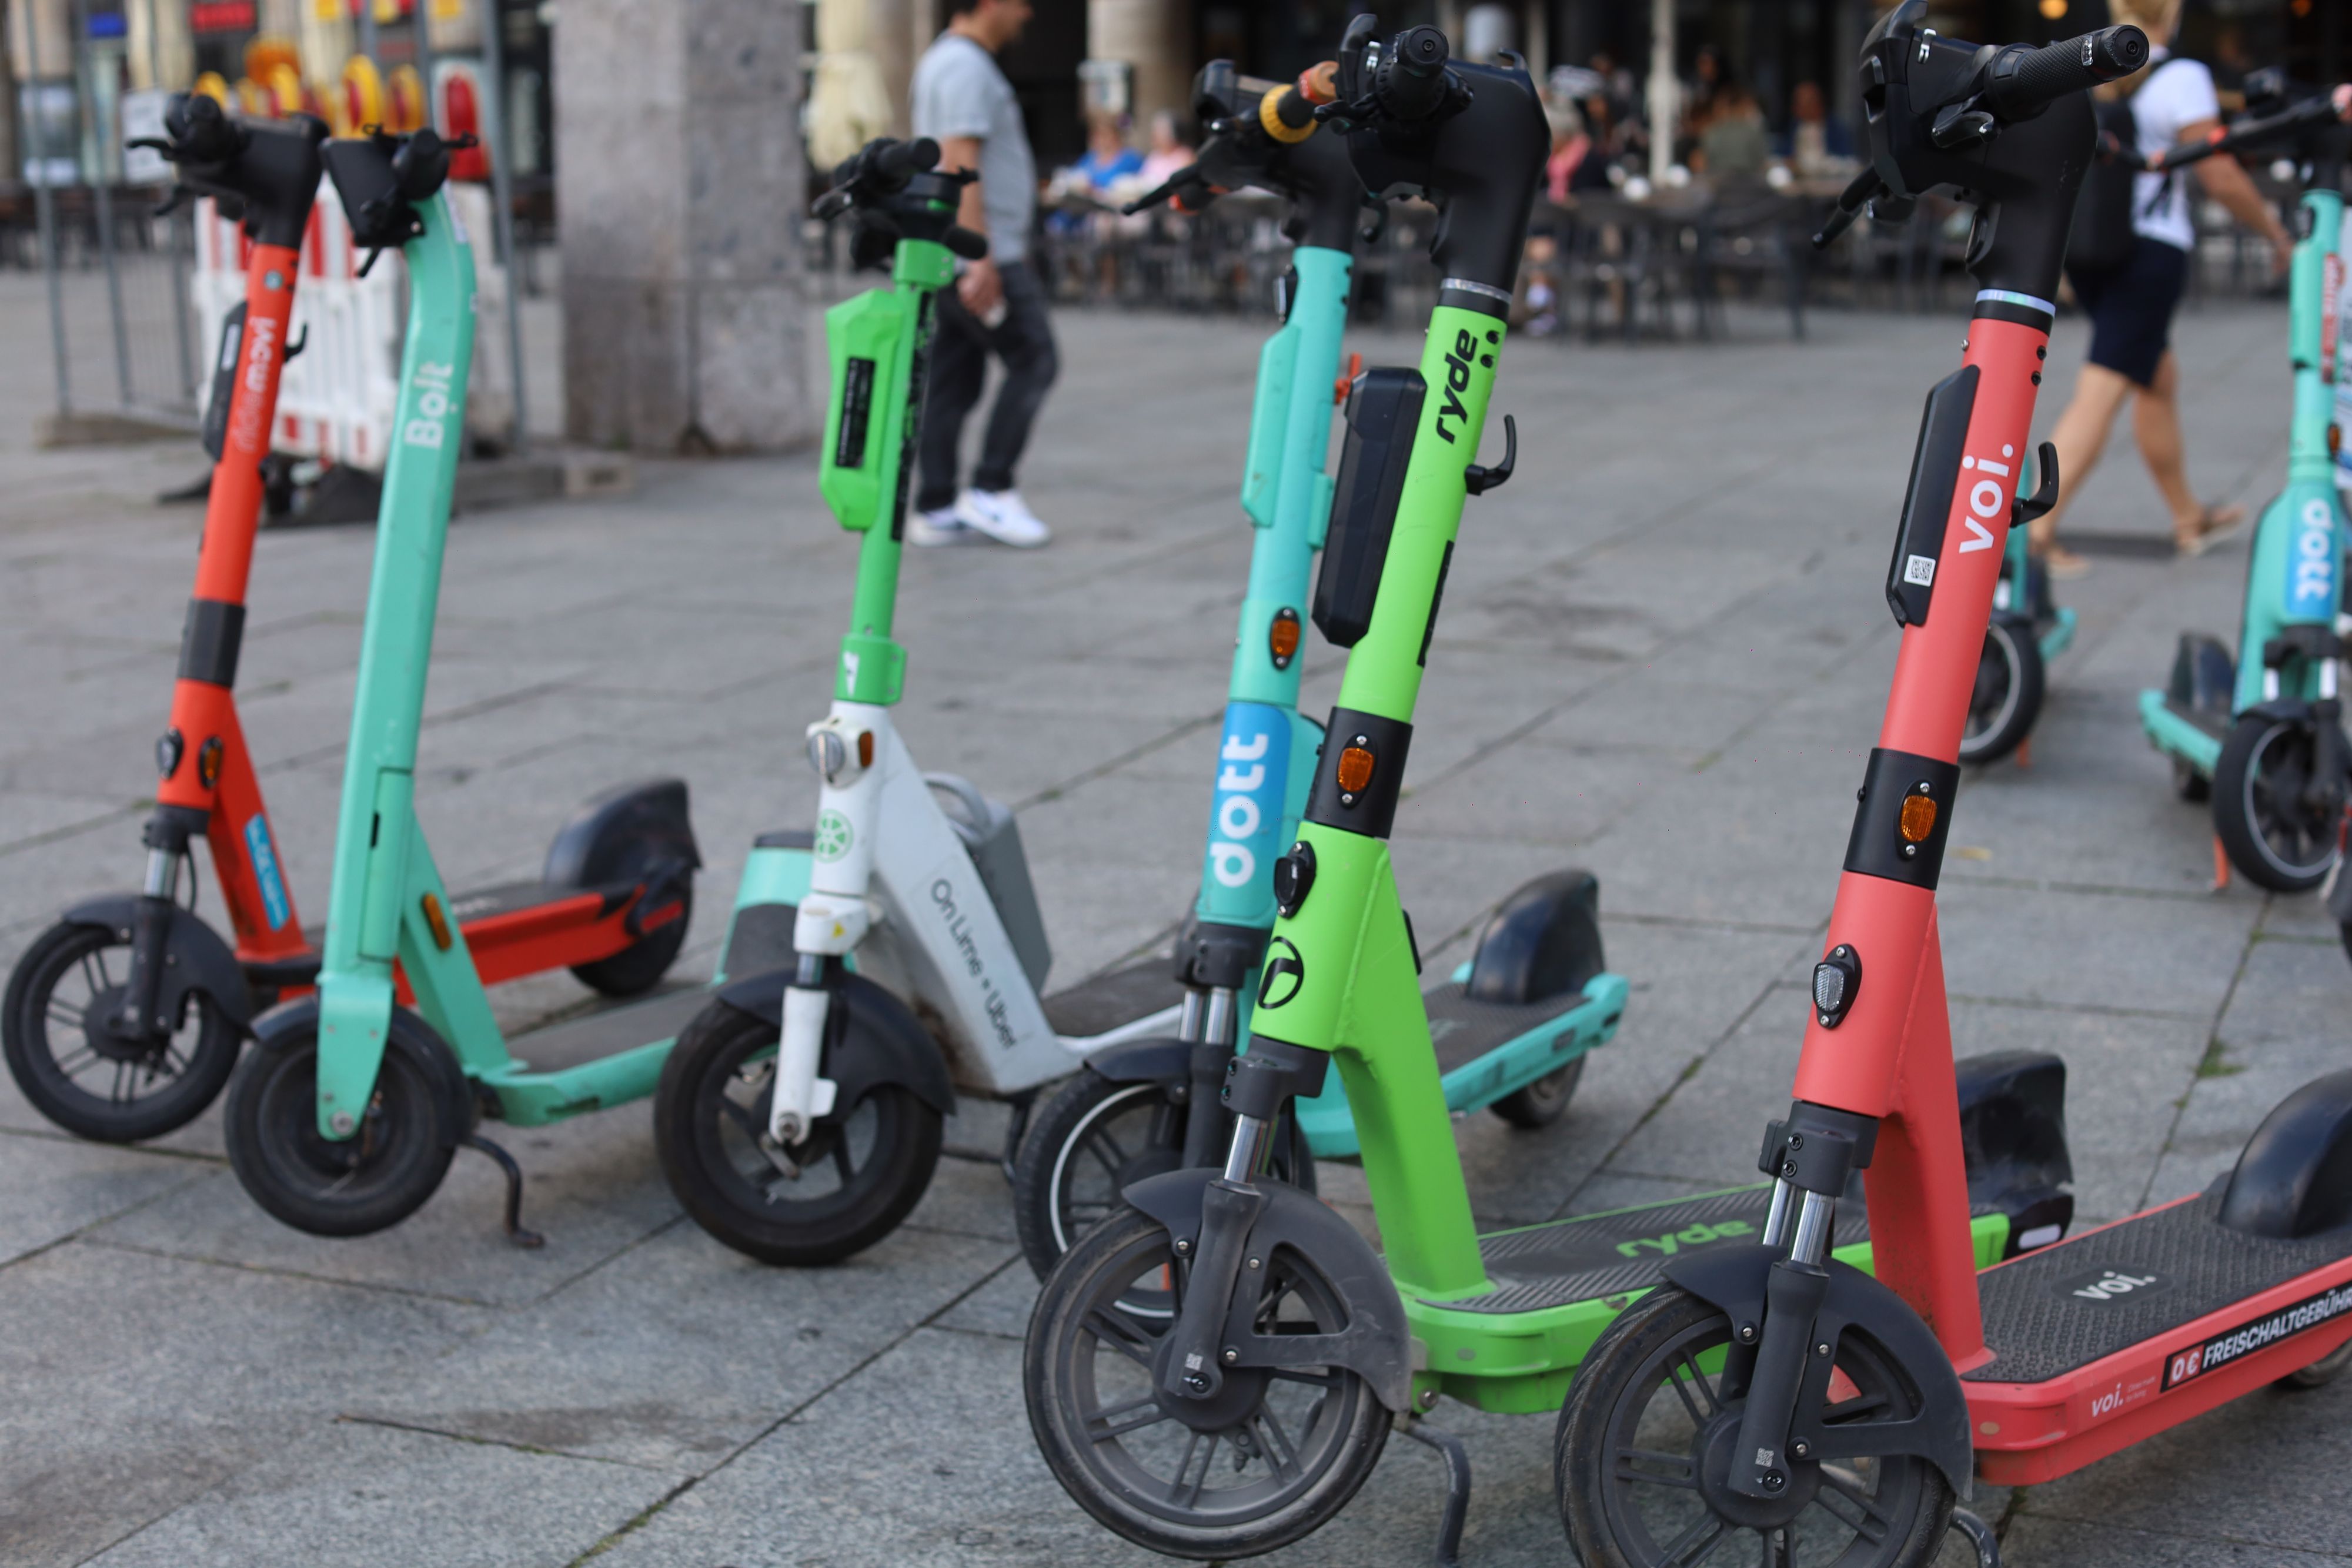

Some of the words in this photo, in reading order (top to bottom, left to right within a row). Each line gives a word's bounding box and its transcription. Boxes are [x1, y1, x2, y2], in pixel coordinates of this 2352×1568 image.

[404, 360, 455, 449] Bolt
[1436, 329, 1478, 444] ryde
[1959, 444, 2013, 553] voi.
[2294, 498, 2333, 600] dott
[1210, 733, 1269, 887] dott
[931, 878, 957, 921] On
[950, 914, 984, 978] Lime
[985, 989, 1018, 1050] Uber
[1616, 1220, 1756, 1258] ryde
[2073, 1271, 2156, 1300] voi.
[2092, 1383, 2124, 1417] voi.
